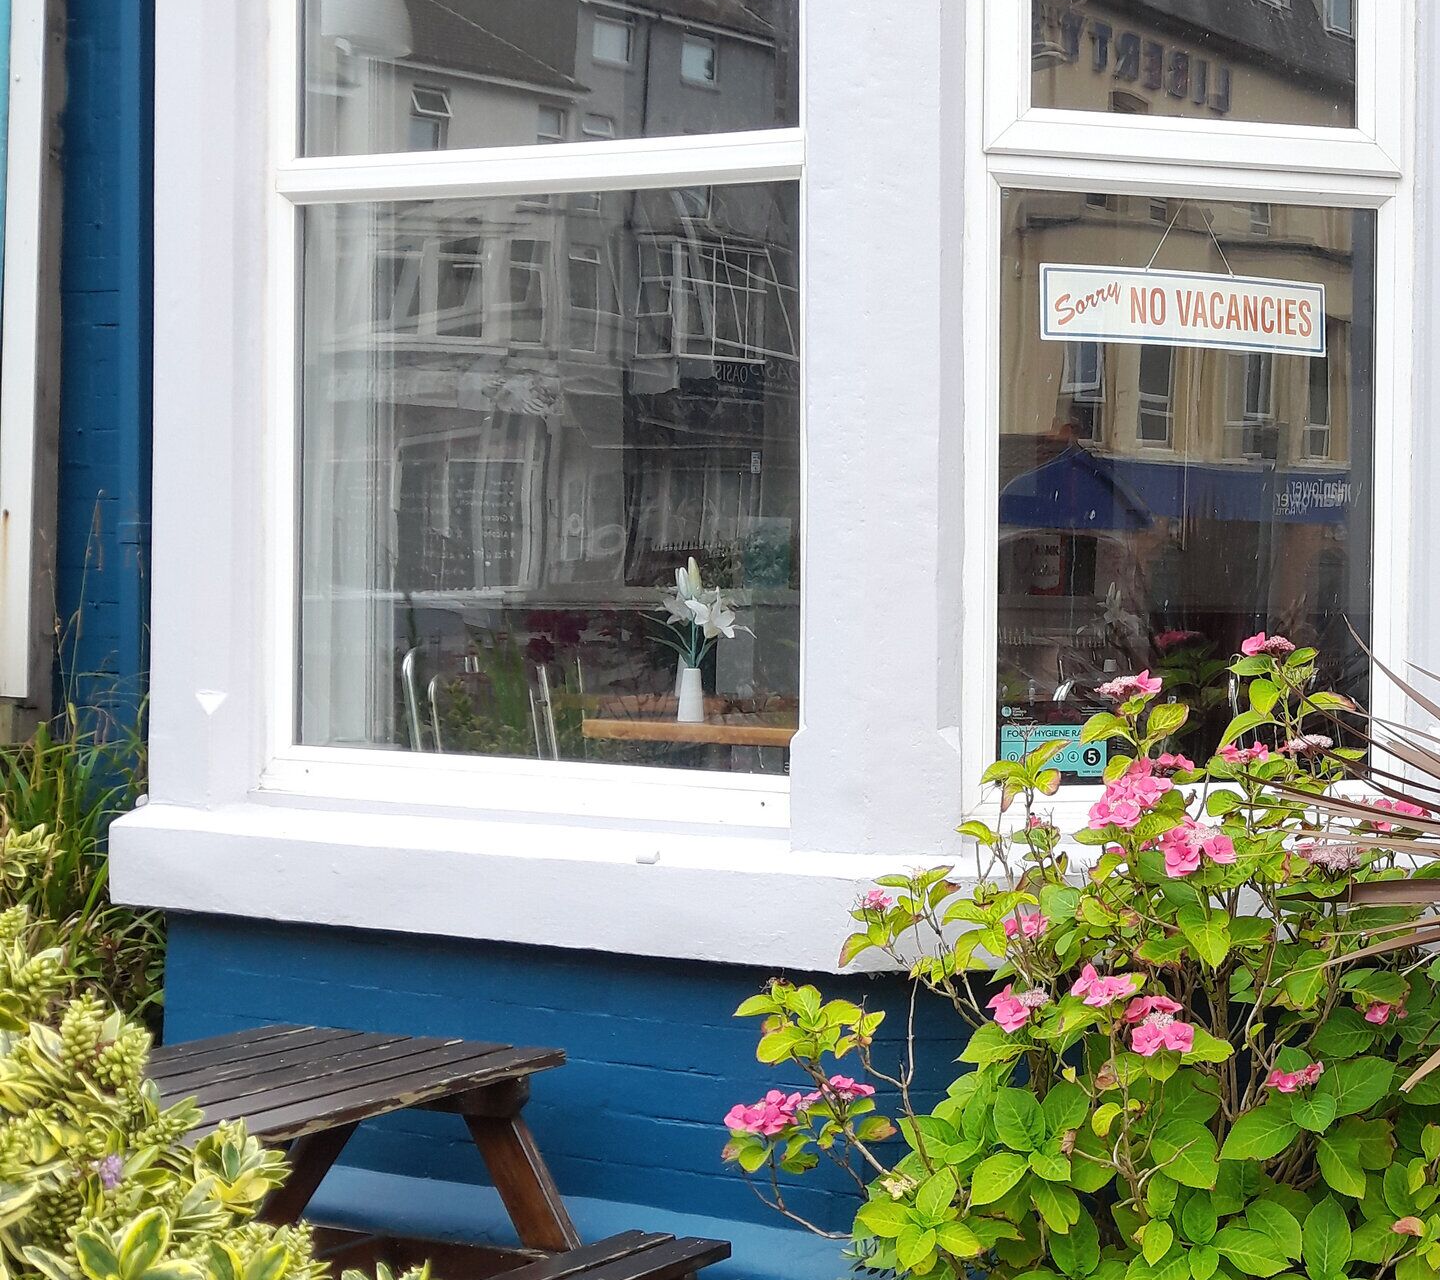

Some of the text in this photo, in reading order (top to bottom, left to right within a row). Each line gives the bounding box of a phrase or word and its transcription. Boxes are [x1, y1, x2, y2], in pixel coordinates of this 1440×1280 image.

[1053, 281, 1313, 338] Sorry NO VACANCIES
[1034, 729, 1070, 737] HYGIENE
[1086, 749, 1097, 764] 5
